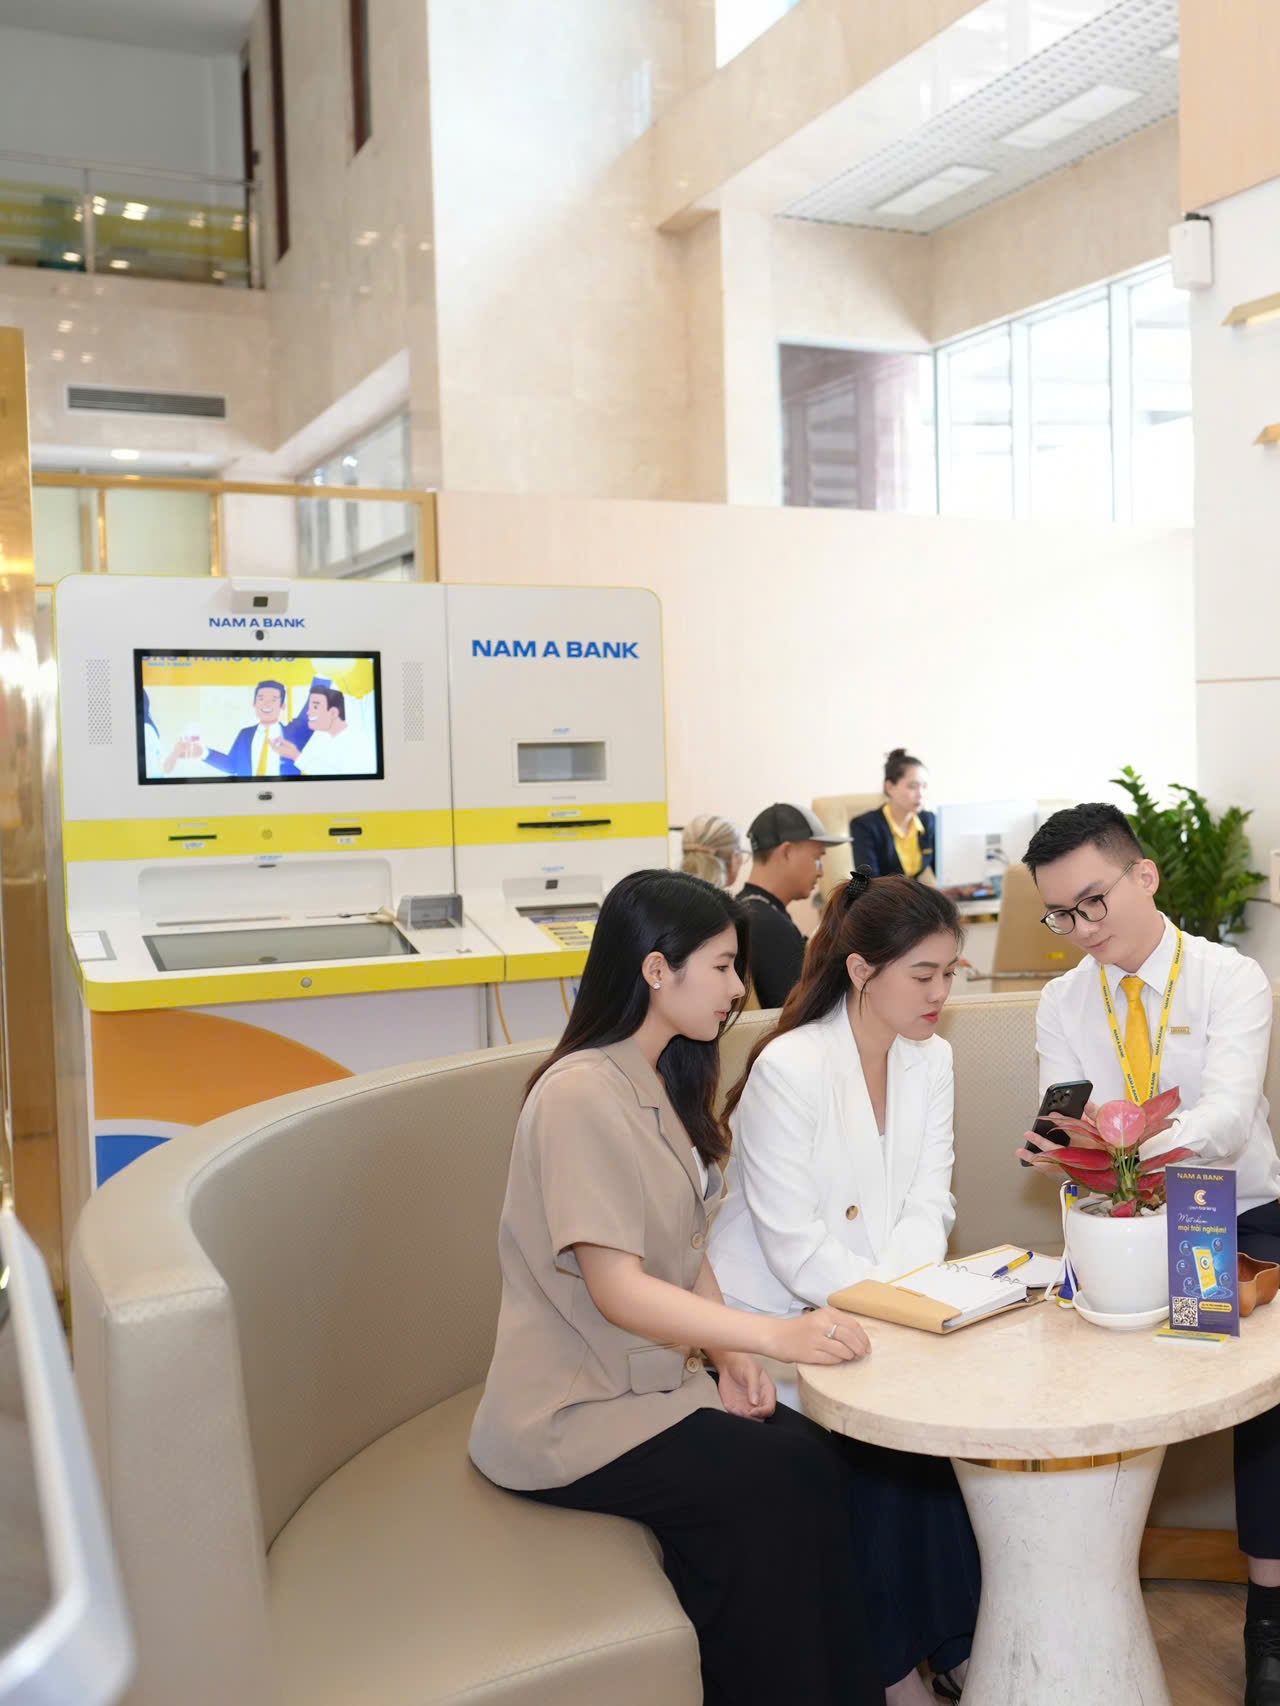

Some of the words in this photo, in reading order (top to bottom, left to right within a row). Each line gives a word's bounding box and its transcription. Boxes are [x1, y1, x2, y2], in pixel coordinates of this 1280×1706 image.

[209, 617, 246, 628] NAM
[250, 617, 260, 628] A
[263, 618, 305, 628] BANK
[472, 640, 537, 657] NAM
[542, 641, 561, 658] A
[566, 641, 640, 659] BANK
